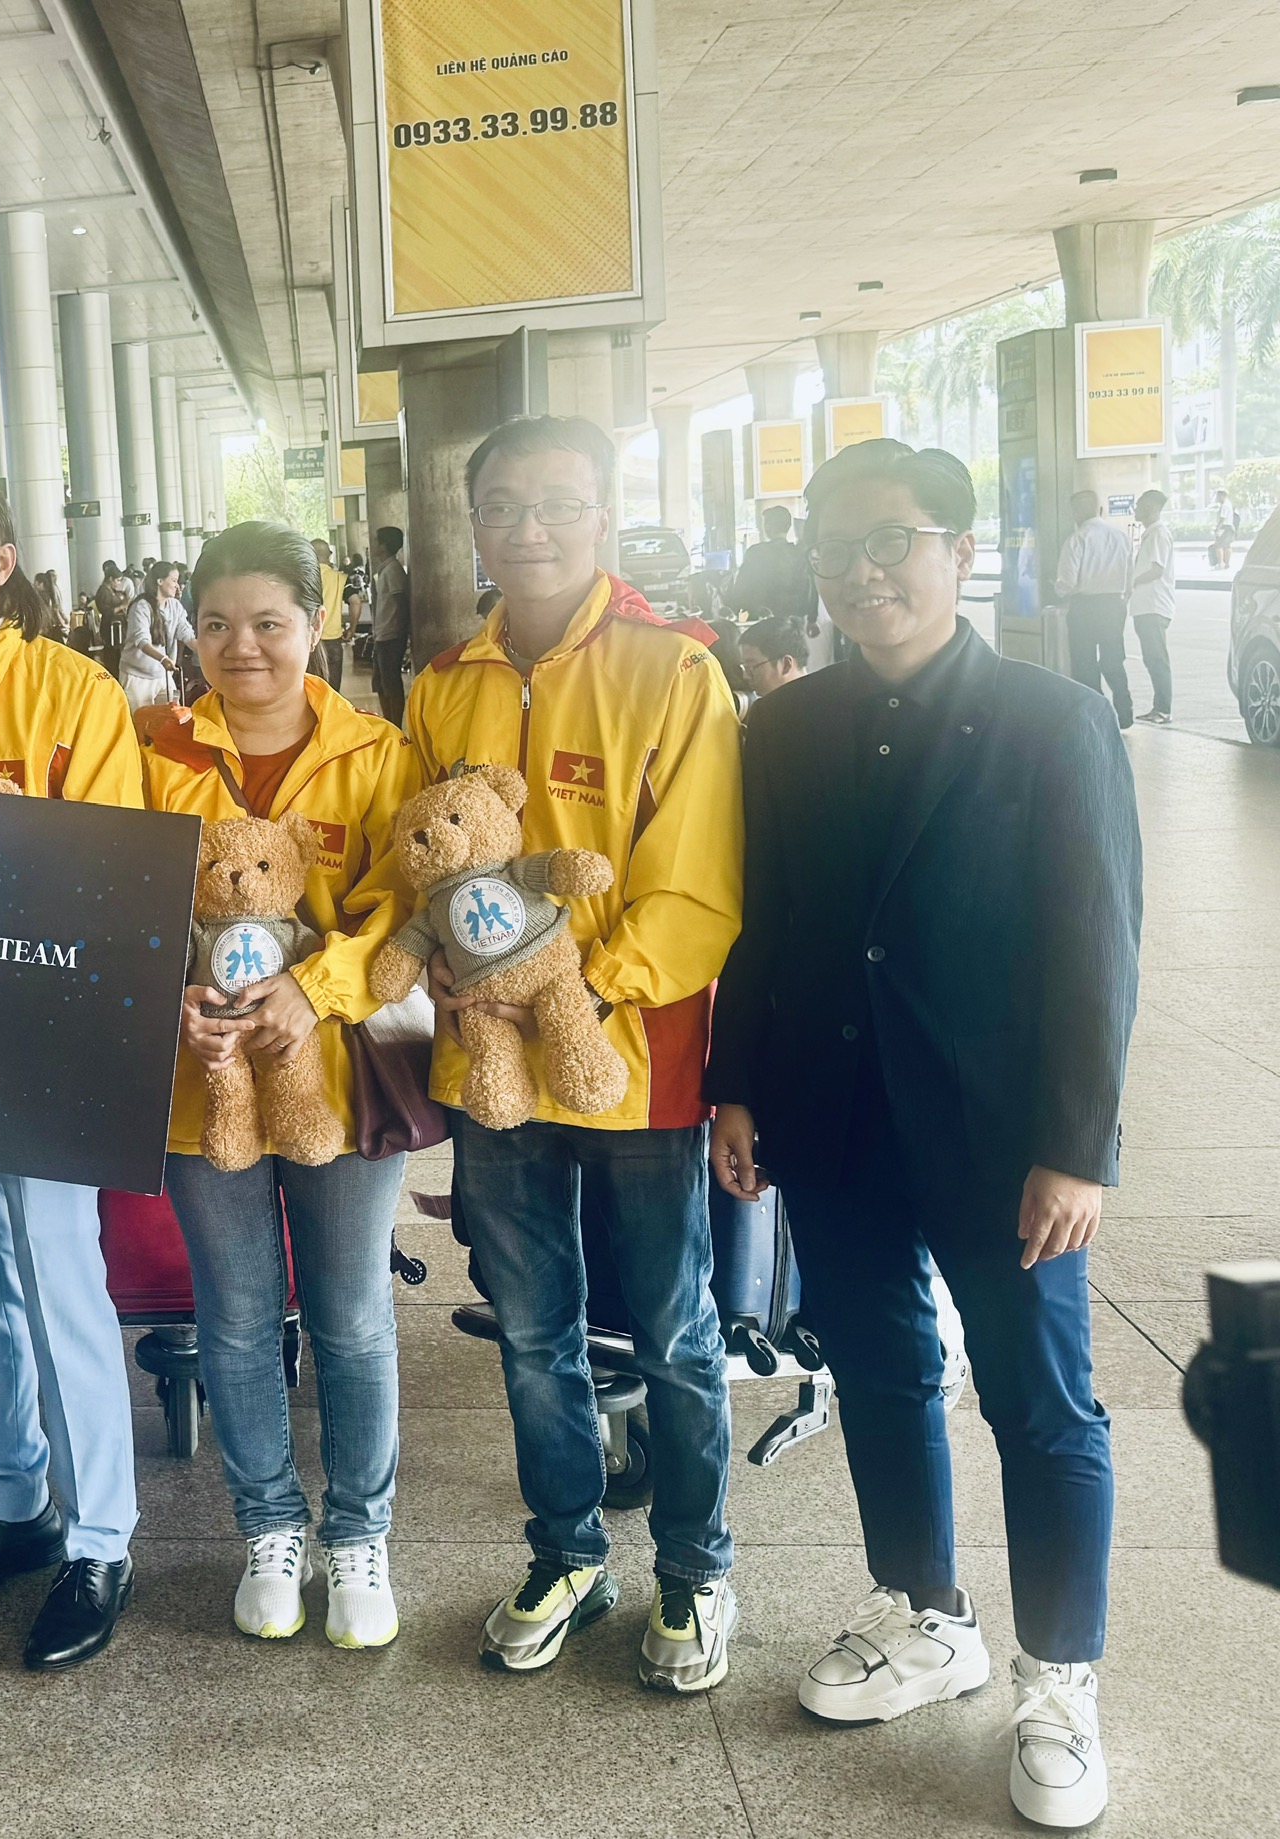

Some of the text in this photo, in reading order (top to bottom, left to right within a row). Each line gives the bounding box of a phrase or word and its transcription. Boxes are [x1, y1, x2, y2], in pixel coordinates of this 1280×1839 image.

[436, 49, 569, 76] LIÊN HỆ QUẢNG CÁO
[393, 101, 618, 149] 0933.33.99.88
[80, 504, 89, 515] 7
[548, 786, 605, 808] VIET NAM
[316, 854, 343, 869] NAM
[471, 929, 517, 949] VIETNAM
